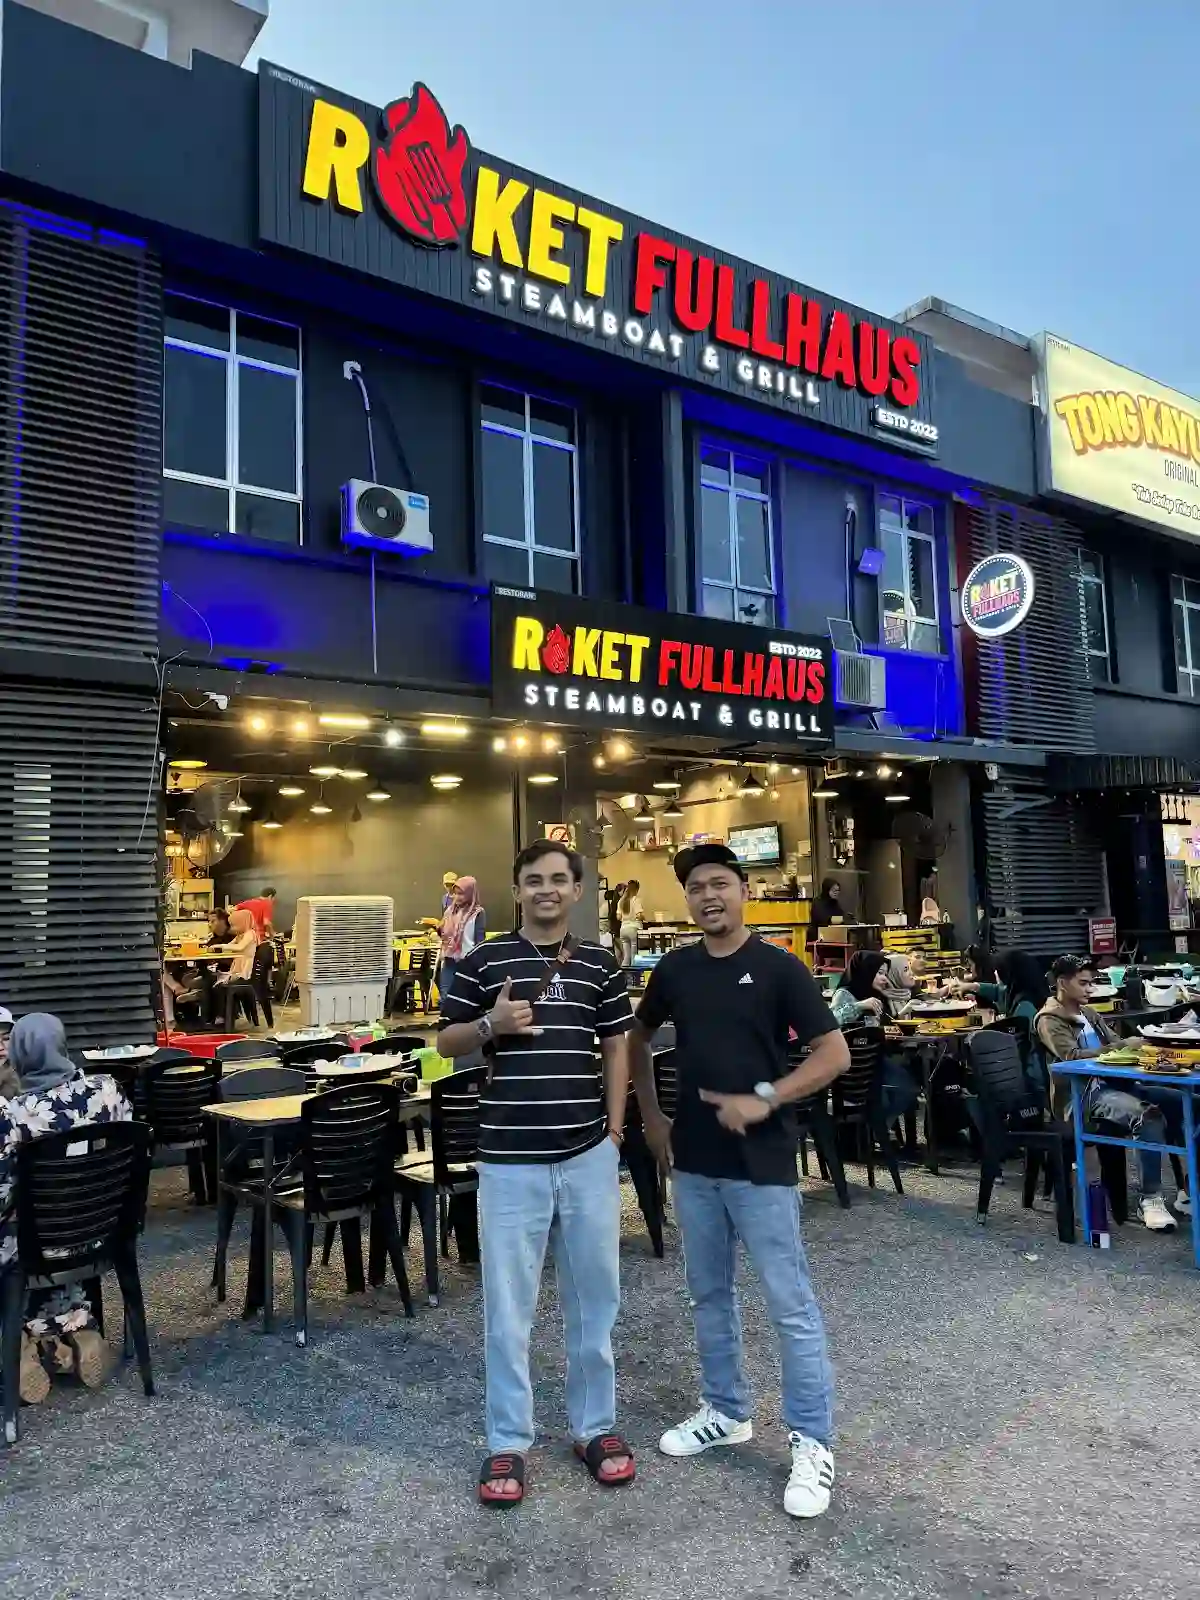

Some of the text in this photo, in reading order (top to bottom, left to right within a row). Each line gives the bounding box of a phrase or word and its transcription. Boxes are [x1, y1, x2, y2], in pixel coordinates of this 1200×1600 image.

[475, 266, 820, 405] STEAMBOAT & GRILL
[634, 231, 921, 408] FULLHAUS
[877, 408, 939, 441] ESTD 2022
[1055, 390, 1144, 456] TONG
[1164, 459, 1199, 488] ORIGINAL
[658, 640, 825, 704] FULLHAUS
[769, 641, 822, 660] ESTD 2022
[524, 684, 821, 732] STEAMBOAT & GRILL
